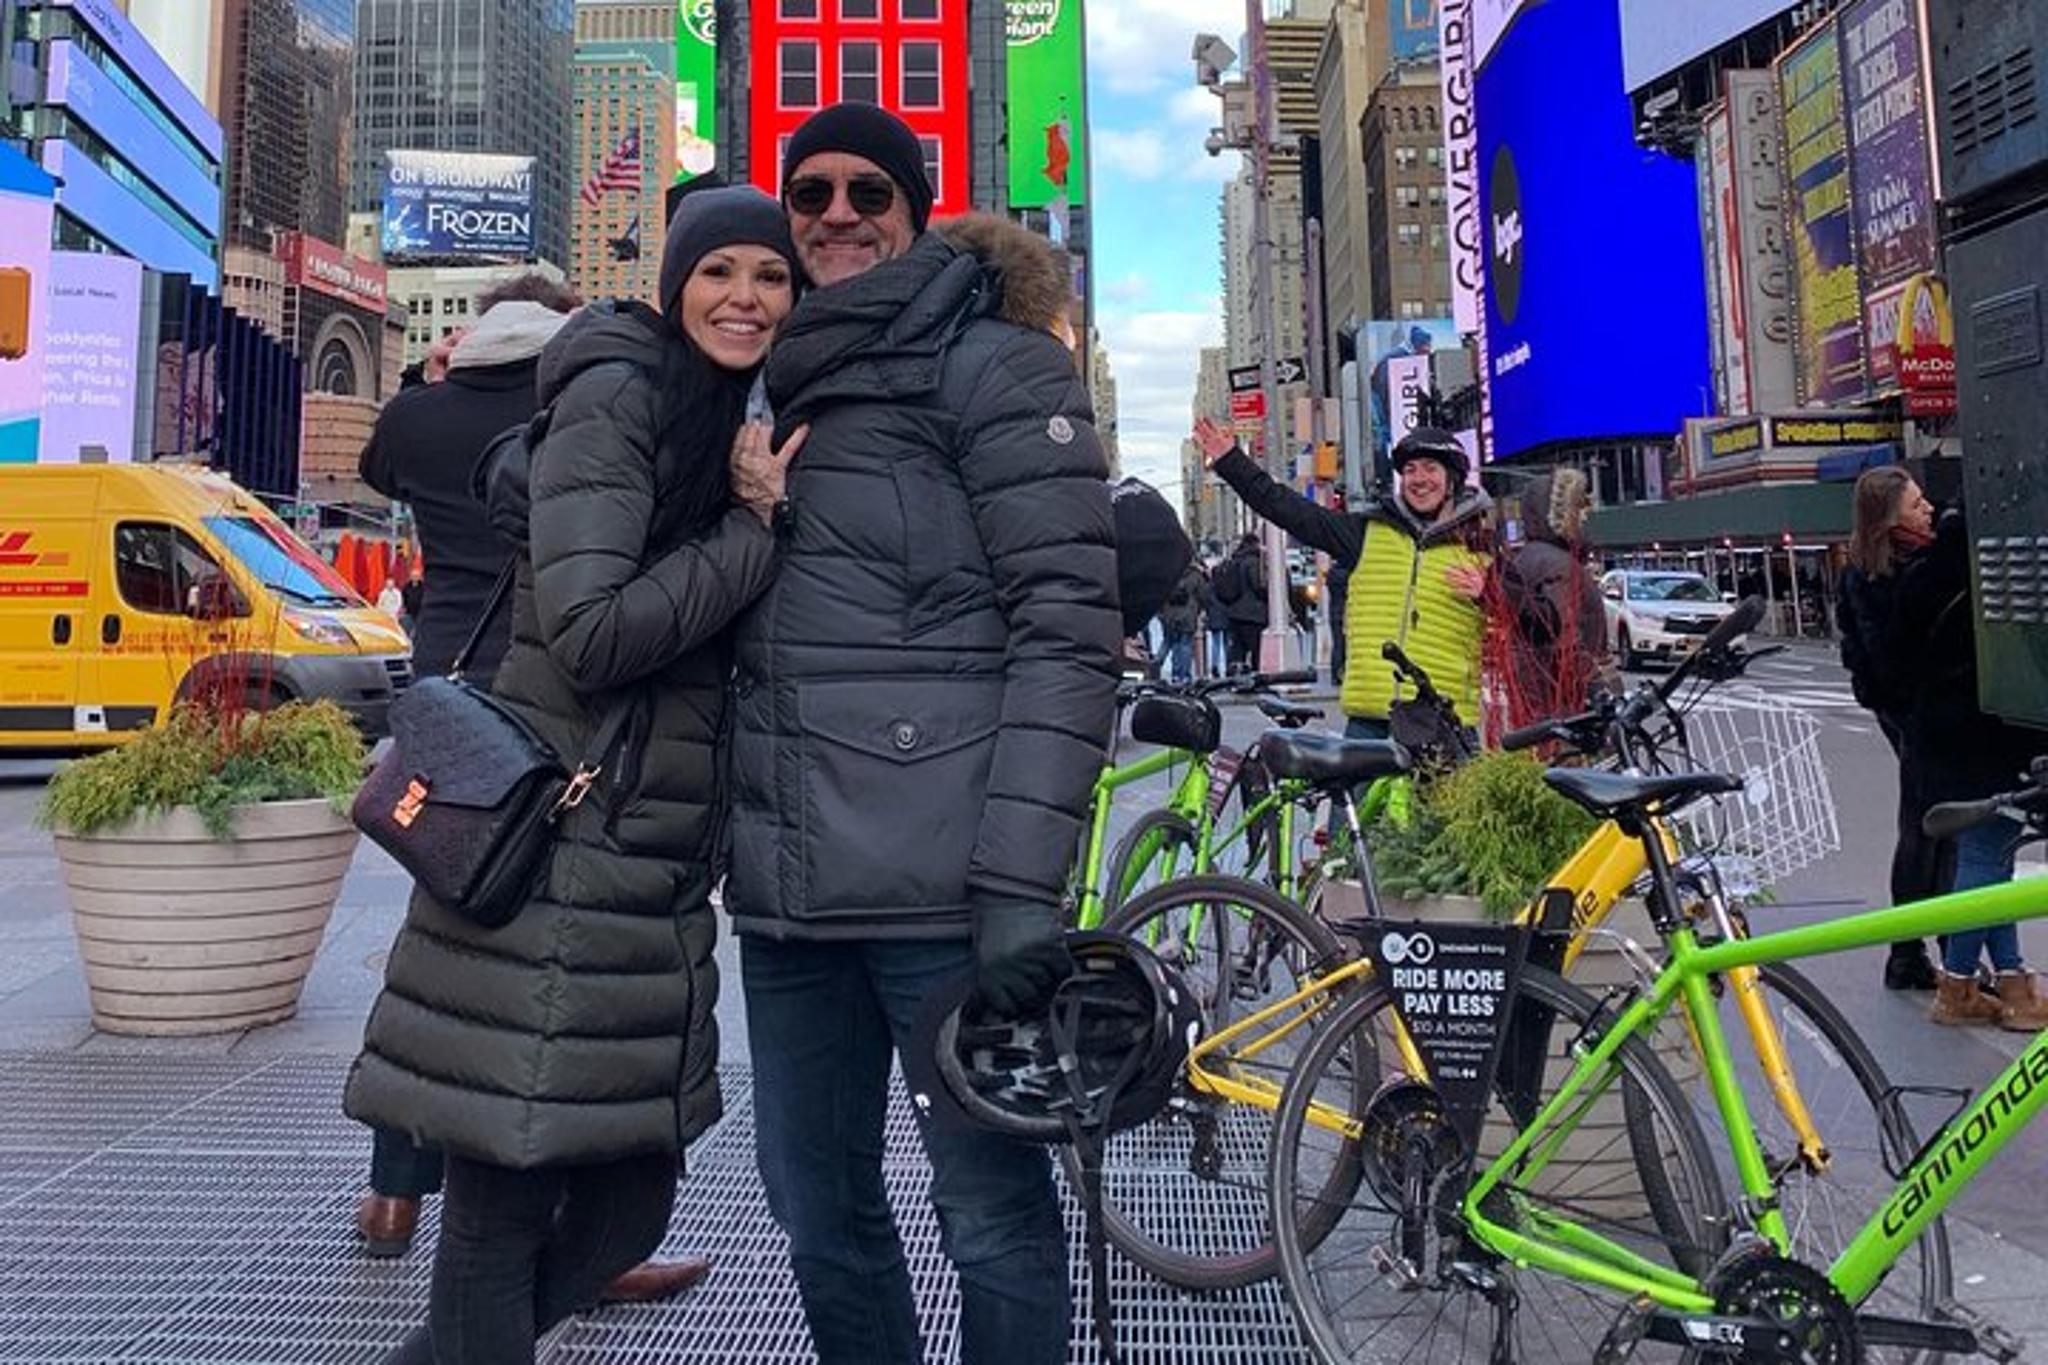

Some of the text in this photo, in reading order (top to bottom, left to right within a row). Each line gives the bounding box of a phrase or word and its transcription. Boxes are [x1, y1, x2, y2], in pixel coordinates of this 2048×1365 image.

[390, 166, 531, 192] ON BROADWAY!
[427, 204, 531, 239] FROZEN
[1392, 968, 1506, 991] RIDE MORE
[1404, 993, 1443, 1014] PAY
